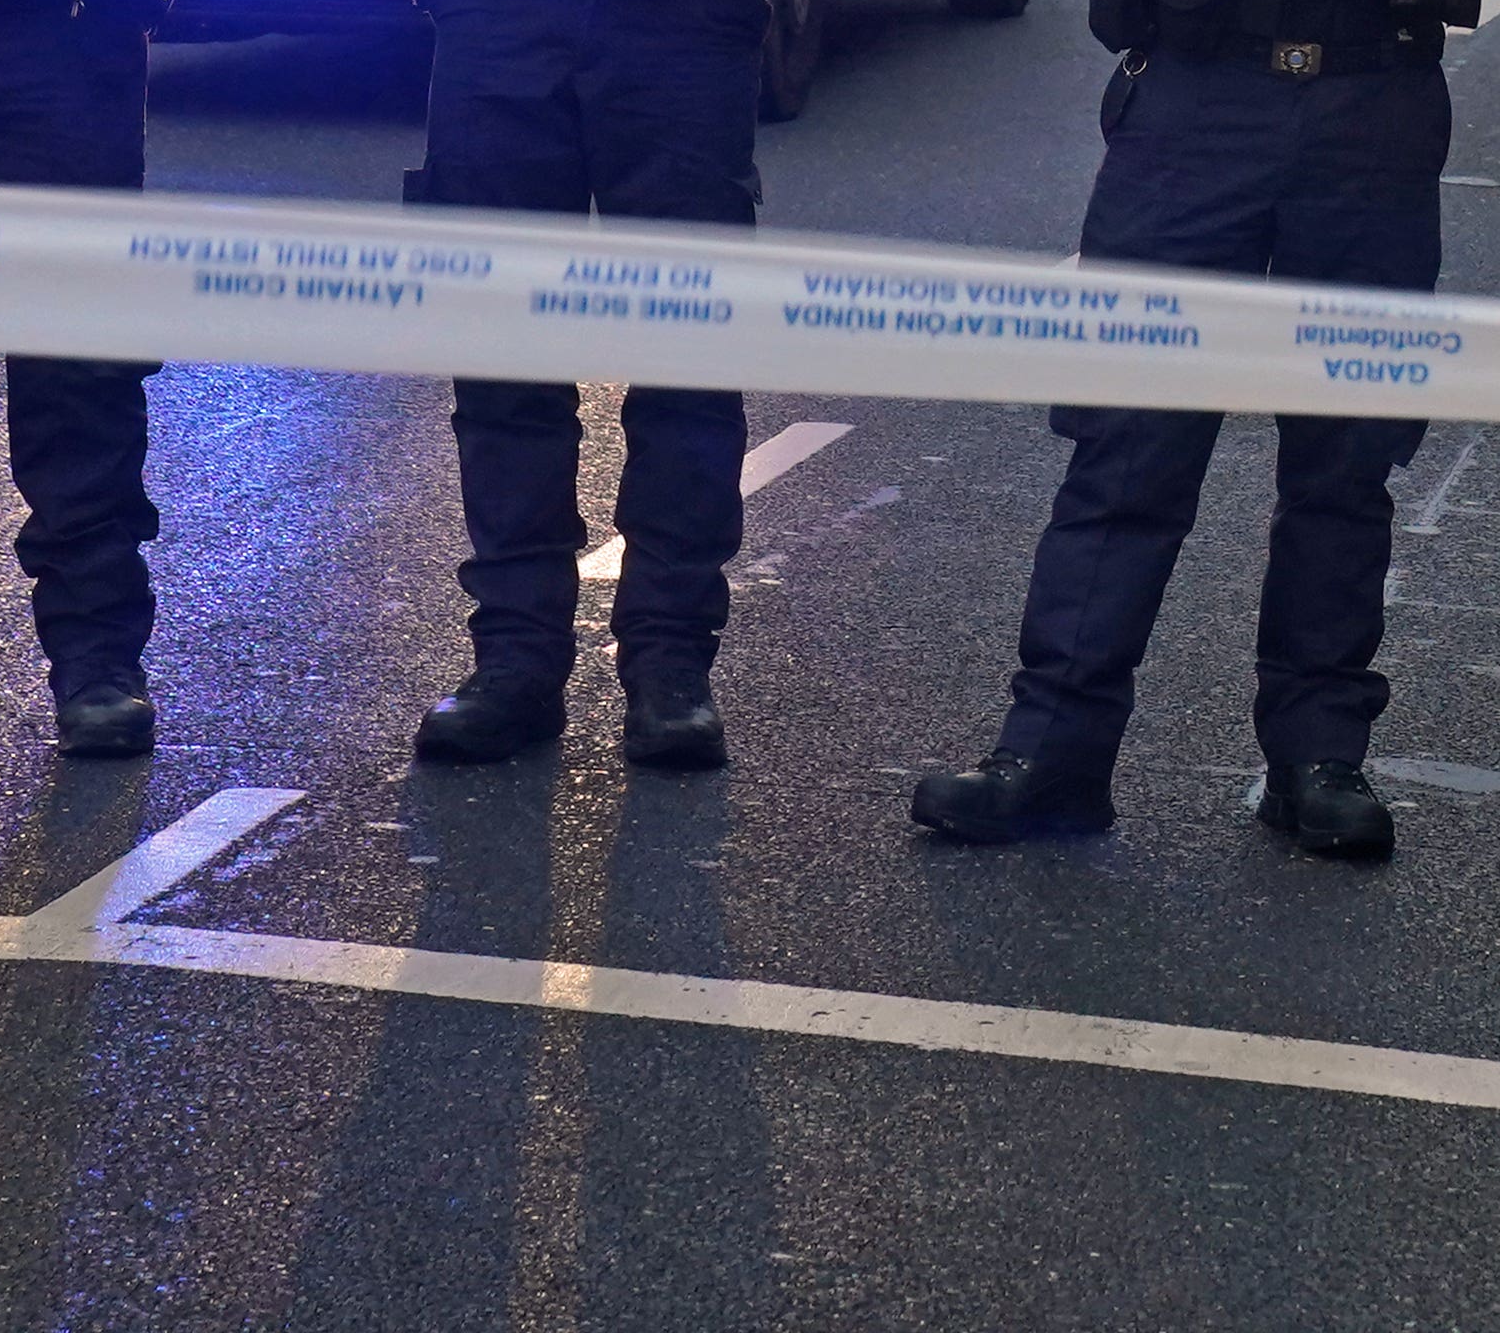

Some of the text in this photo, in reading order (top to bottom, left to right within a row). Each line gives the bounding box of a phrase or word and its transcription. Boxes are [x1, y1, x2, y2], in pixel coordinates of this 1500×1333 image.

[129, 235, 493, 280] COSC AR DHUL ISTEACH
[194, 270, 424, 309] LÁTHAIR COIRE
[563, 258, 713, 290] NO ENTRY
[803, 273, 956, 307] SÍOCHÁNA
[530, 290, 733, 323] CRIME SCENE
[965, 283, 1071, 310] GARDA
[1079, 289, 1120, 311] AN
[781, 302, 1200, 347] UIMHIR THEILEAFÓIN RÚNDA
[1295, 324, 1462, 354] Confidential
[1325, 359, 1429, 384] GARDA
